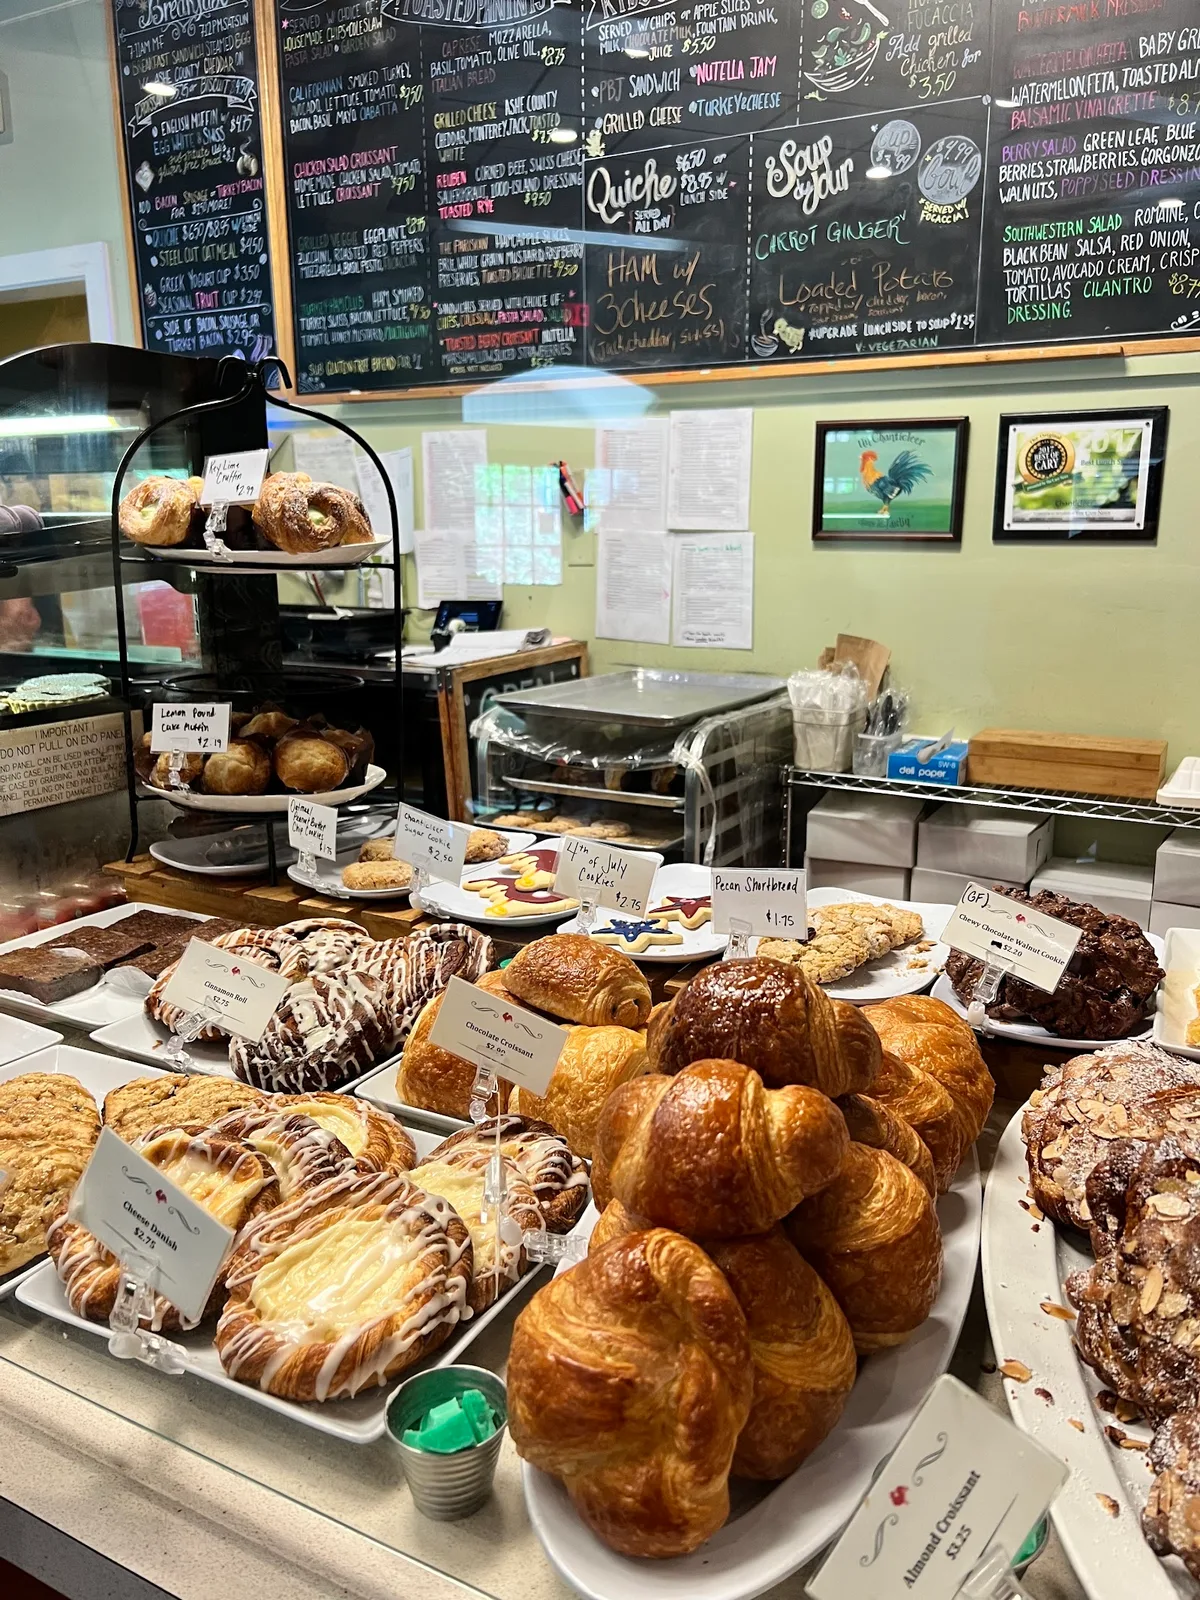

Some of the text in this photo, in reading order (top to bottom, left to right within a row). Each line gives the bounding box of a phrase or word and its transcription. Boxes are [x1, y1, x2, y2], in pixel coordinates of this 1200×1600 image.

[489, 21, 552, 46] MOZZARELLA,
[599, 22, 632, 41] SERVED
[650, 12, 676, 30] CHIPS
[694, 4, 717, 21] APPLE
[696, 17, 737, 37] FOUNTAIN
[741, 8, 778, 28] DRINK,
[498, 45, 520, 61] OLIVE
[649, 45, 673, 61] JUICE
[886, 24, 973, 61] Add grilled
[1139, 31, 1176, 58] BABY
[961, 48, 982, 68] for
[348, 70, 378, 90] SMOKED
[600, 55, 777, 103] PBJ SANDWICH NUTELLA JAM
[909, 71, 957, 99] $3.50
[1011, 63, 1177, 106] WATERMELON, FETA, TOASTED
[434, 90, 558, 129] GRILLED CHEESE ASHE COUNTY
[603, 109, 645, 135] GRILLED
[650, 106, 683, 127] CHEESE
[1011, 101, 1071, 130] BALSAMIC
[1084, 122, 1196, 152] GREEN LEAF, BLUE
[713, 154, 727, 165] or
[1003, 136, 1076, 163] BERRY SALAD
[765, 135, 833, 198] Soup
[999, 162, 1044, 183] BERRIES,
[1046, 149, 1138, 177] STRAWBERRIES,
[587, 158, 678, 224] Quiche
[680, 188, 728, 207] LUNCH SIDE
[1000, 181, 1058, 204] WALNUTS,
[1061, 173, 1099, 197] POPPY
[1101, 168, 1134, 190] SEED
[477, 199, 495, 213] RYE
[635, 215, 671, 233] ALL DAY
[1003, 201, 1188, 243] SOUTHWESTERN SALAD ROMAINE,
[755, 216, 910, 261] CARROT GINGER
[1003, 228, 1191, 266] BLACK BEAN SALSA, RED ONION,
[608, 248, 663, 288] HAM
[1003, 266, 1051, 286] TOMATO,
[1053, 260, 1103, 282] AVOCADO
[1108, 254, 1155, 276] CREAM,
[195, 290, 219, 308] FRUIT
[779, 269, 863, 306] Loaded
[1005, 276, 1152, 305] TORTILLAS CILANTRO
[1008, 301, 1072, 325] DRESSING.
[864, 319, 926, 336] LUNCH SIDE TO
[868, 336, 938, 353] VEGETARIAN
[1034, 450, 1059, 461] BEST OF
[1034, 460, 1059, 471] CARY
[161, 707, 216, 718] Lemon Pound
[40, 722, 89, 739] IMPORTANT
[162, 722, 209, 732] Cake Muffin
[0, 730, 125, 759] DO NOT PULL ON END PANEL
[198, 737, 222, 748] $2.19
[12, 751, 81, 772] PANEL CAN BE USED
[45, 761, 82, 774] BUT NEVER
[899, 766, 947, 778] deli paper
[9, 782, 26, 790] CASE
[29, 779, 38, 787] BY
[23, 780, 79, 798] PULLING ON END
[23, 787, 92, 807] PERMANENT DAMAGE
[404, 813, 444, 833] Chanticleer
[405, 824, 451, 849] Sugar Cookie
[428, 846, 453, 862] $2.50
[567, 842, 588, 861] 4th
[579, 868, 614, 887] Cookies
[589, 854, 628, 879] of July
[715, 875, 798, 894] Pecan Shortbread
[616, 891, 641, 910] $2.75
[962, 885, 990, 908] (GF)
[766, 909, 794, 926] $1.75
[959, 913, 1065, 966] Chewy Chocolate Walnut Cookie
[1003, 944, 1022, 957] $2.20
[204, 981, 248, 1004] Cinnamon Roll
[213, 996, 229, 1007] $2.75
[465, 1021, 534, 1059] Chocolate Croissant
[123, 1200, 178, 1252] Cheese Danish
[133, 1227, 156, 1250] $2.75
[902, 1469, 982, 1589] Almond Croissant
[945, 1525, 972, 1561] $3.25
